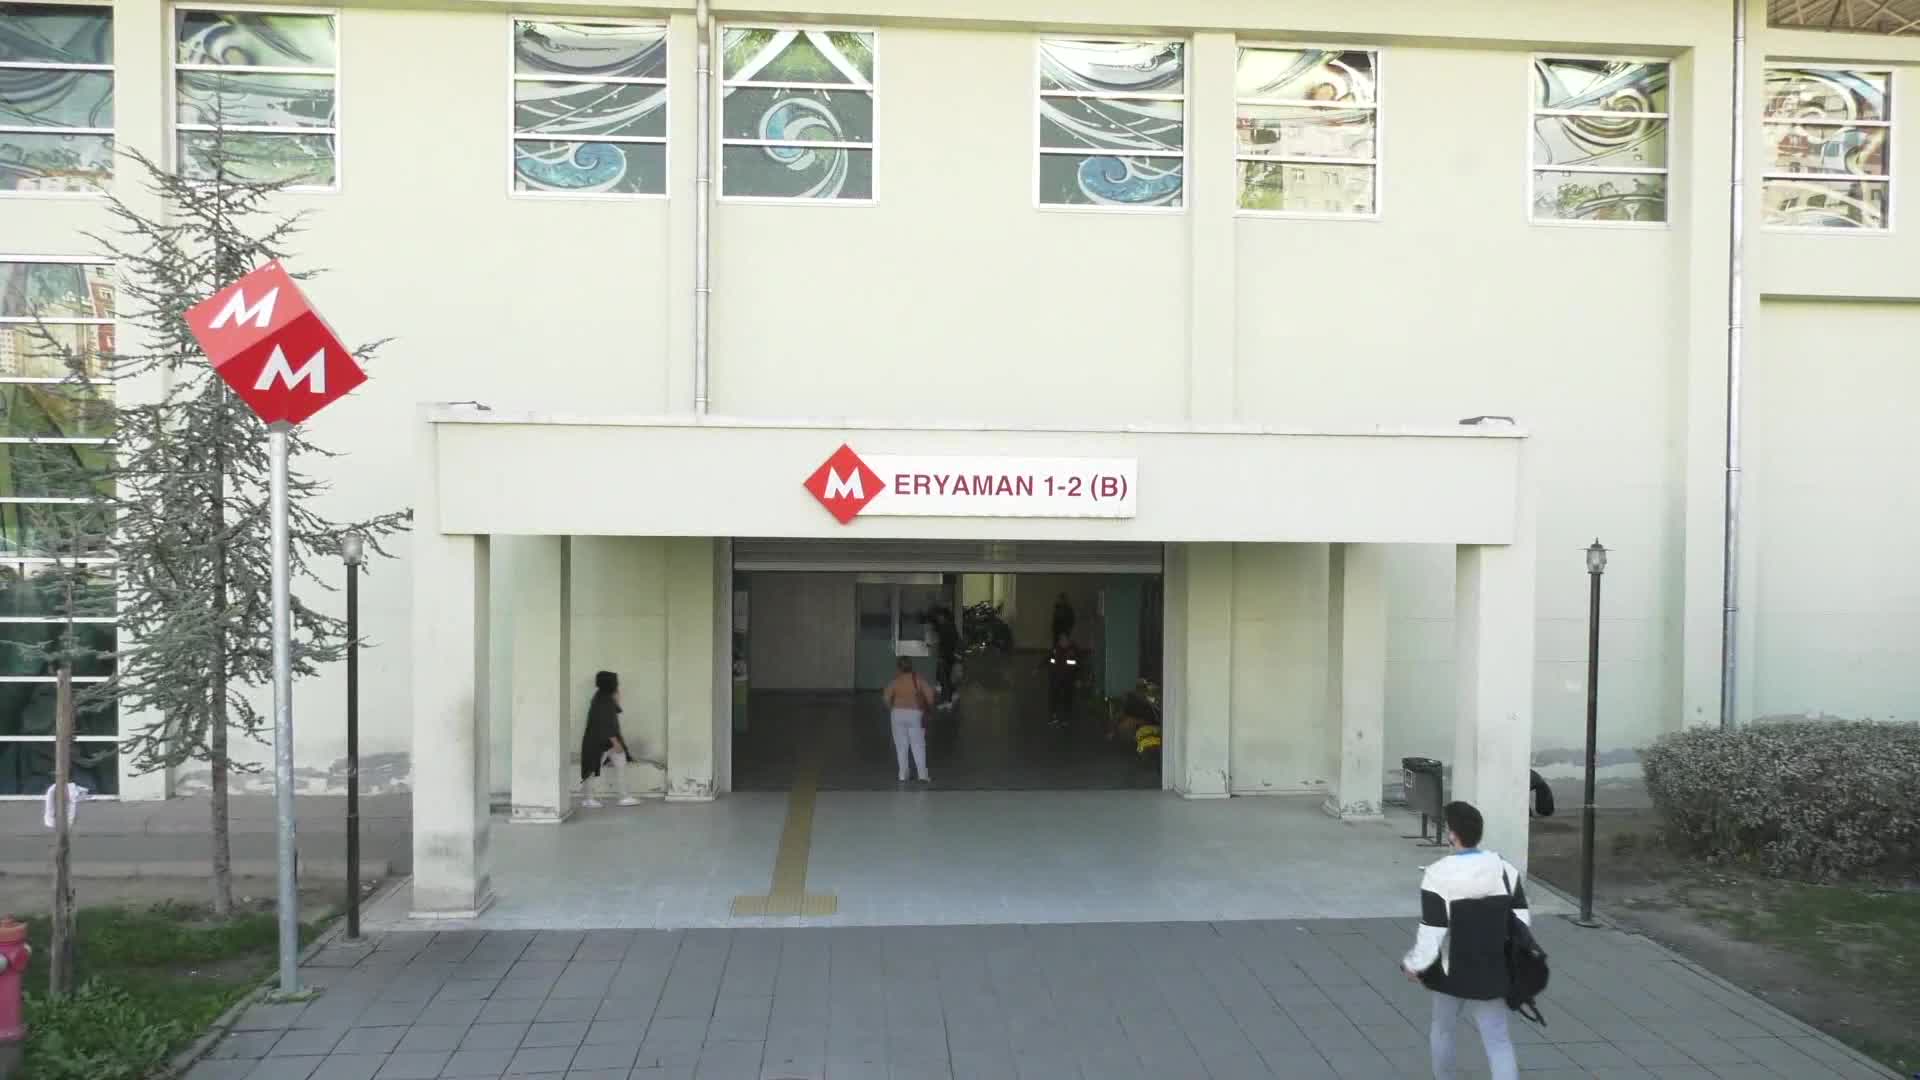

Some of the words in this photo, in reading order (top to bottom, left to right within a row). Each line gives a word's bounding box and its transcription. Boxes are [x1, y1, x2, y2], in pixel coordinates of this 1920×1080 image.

[208, 287, 280, 328] M
[253, 343, 326, 394] M
[824, 465, 865, 500] M
[895, 474, 1033, 496] ERYAMAN
[1044, 476, 1082, 497] 1-2
[1090, 474, 1128, 502] (B)
